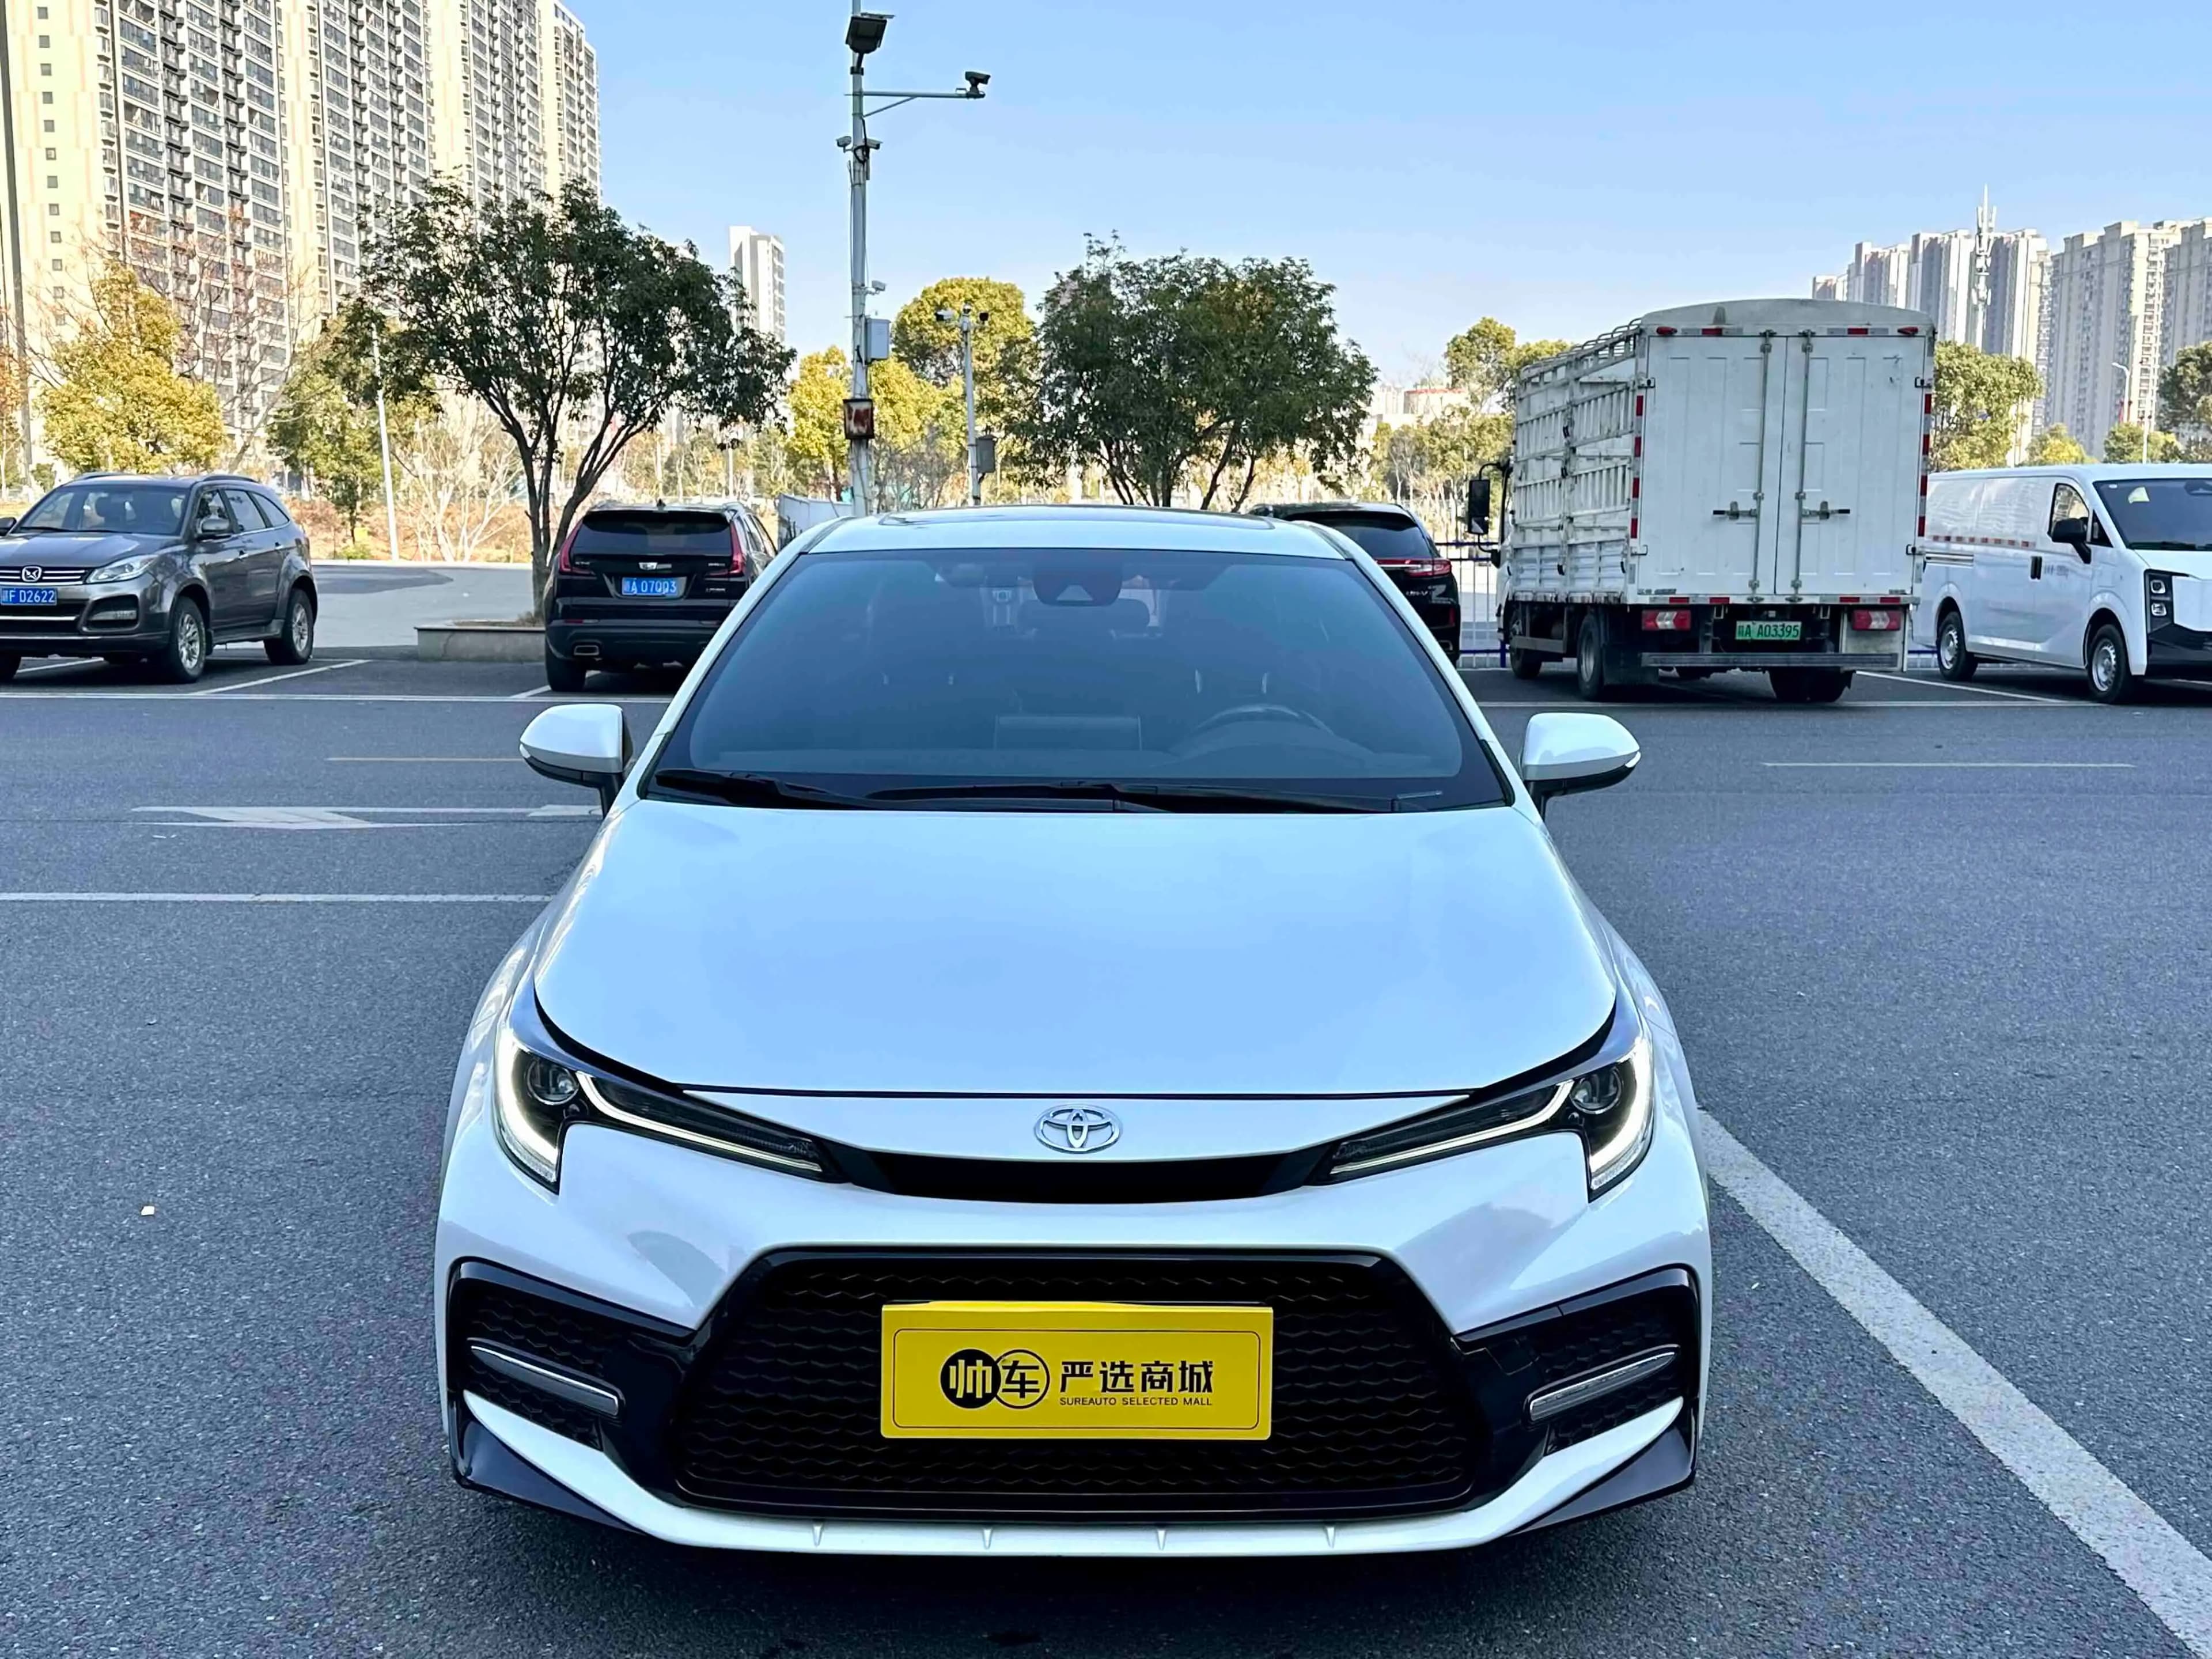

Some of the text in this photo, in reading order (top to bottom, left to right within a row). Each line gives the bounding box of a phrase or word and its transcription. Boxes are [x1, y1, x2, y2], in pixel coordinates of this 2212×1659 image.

[1059, 1360, 1213, 1393] 严选商城
[1059, 1397, 1213, 1406] SUREAUTO SELECTED MALL
